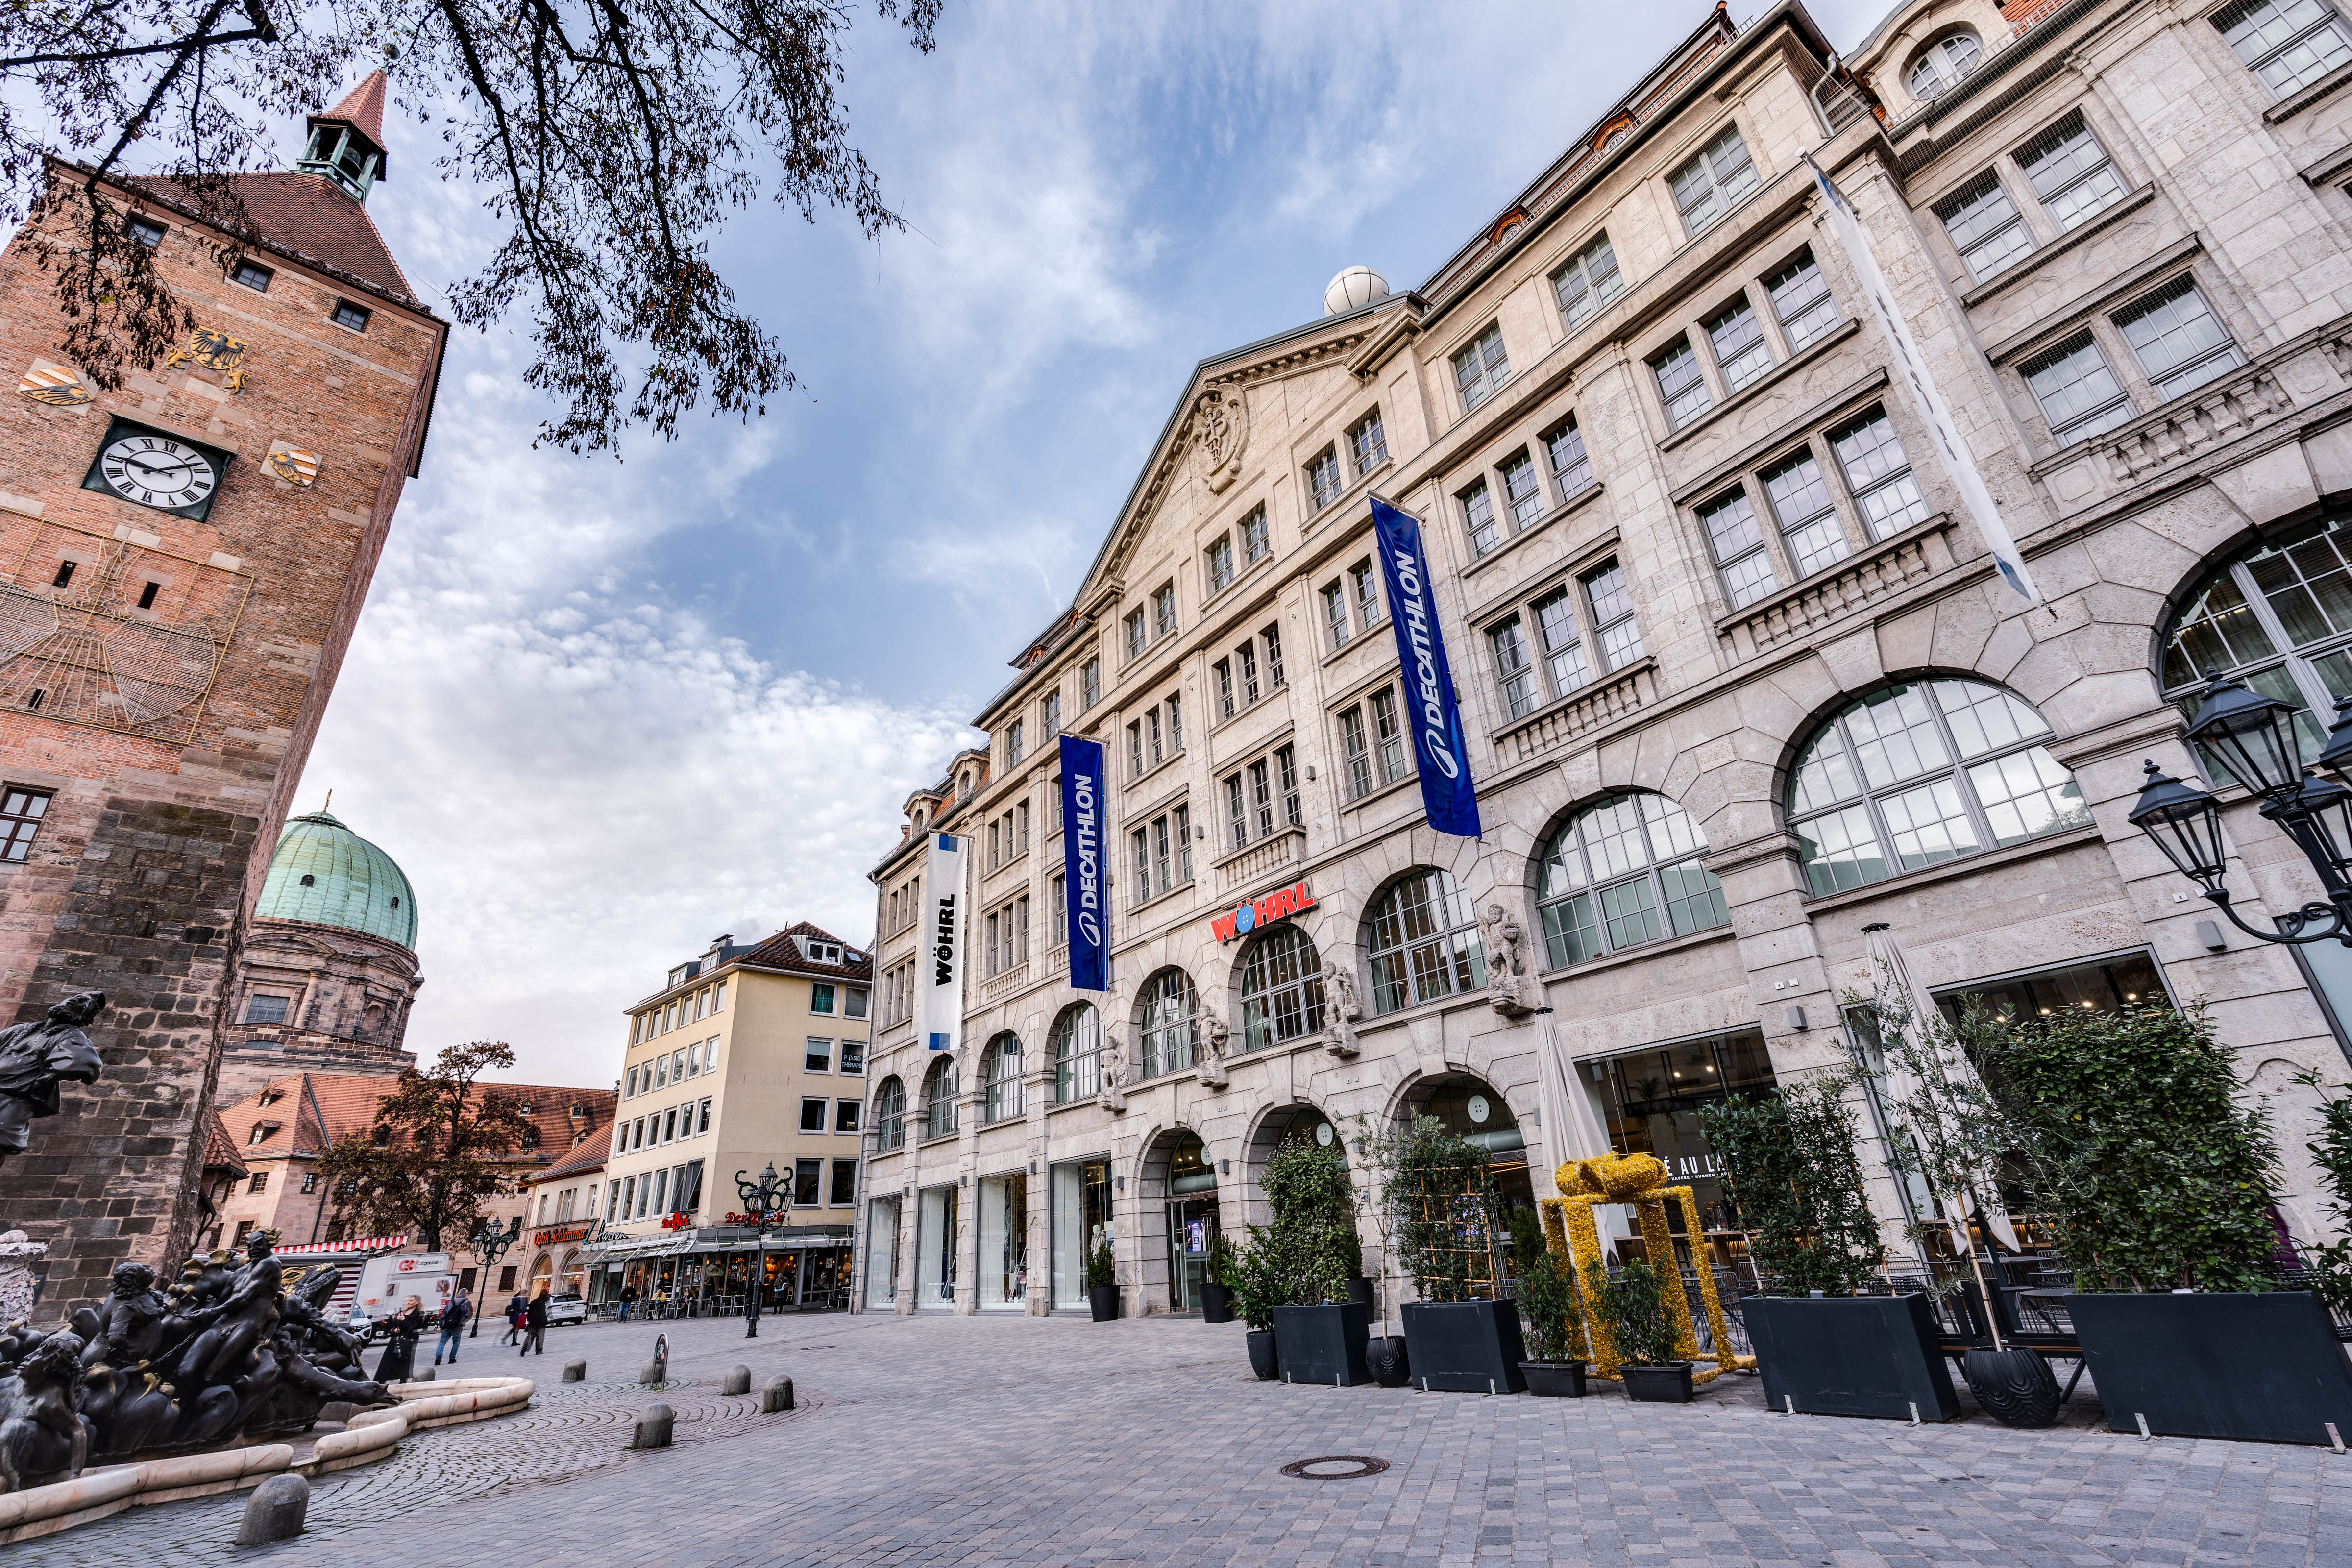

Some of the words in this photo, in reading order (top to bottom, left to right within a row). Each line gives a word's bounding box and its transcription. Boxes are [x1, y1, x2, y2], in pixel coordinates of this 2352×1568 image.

[1395, 549, 1445, 729] DECATHLON
[1075, 774, 1098, 910] DECATHLON
[1210, 882, 1315, 943] WÖHRL
[932, 894, 955, 987] WÖHRL
[1462, 1126, 1486, 1134] HERZLICH
[1680, 1157, 1698, 1175] AU
[661, 1218, 671, 1228] Der
[671, 1211, 689, 1231] Beck
[725, 1212, 747, 1223] Der
[534, 1231, 549, 1247] Optik
[550, 1228, 587, 1243] Schlemmer
